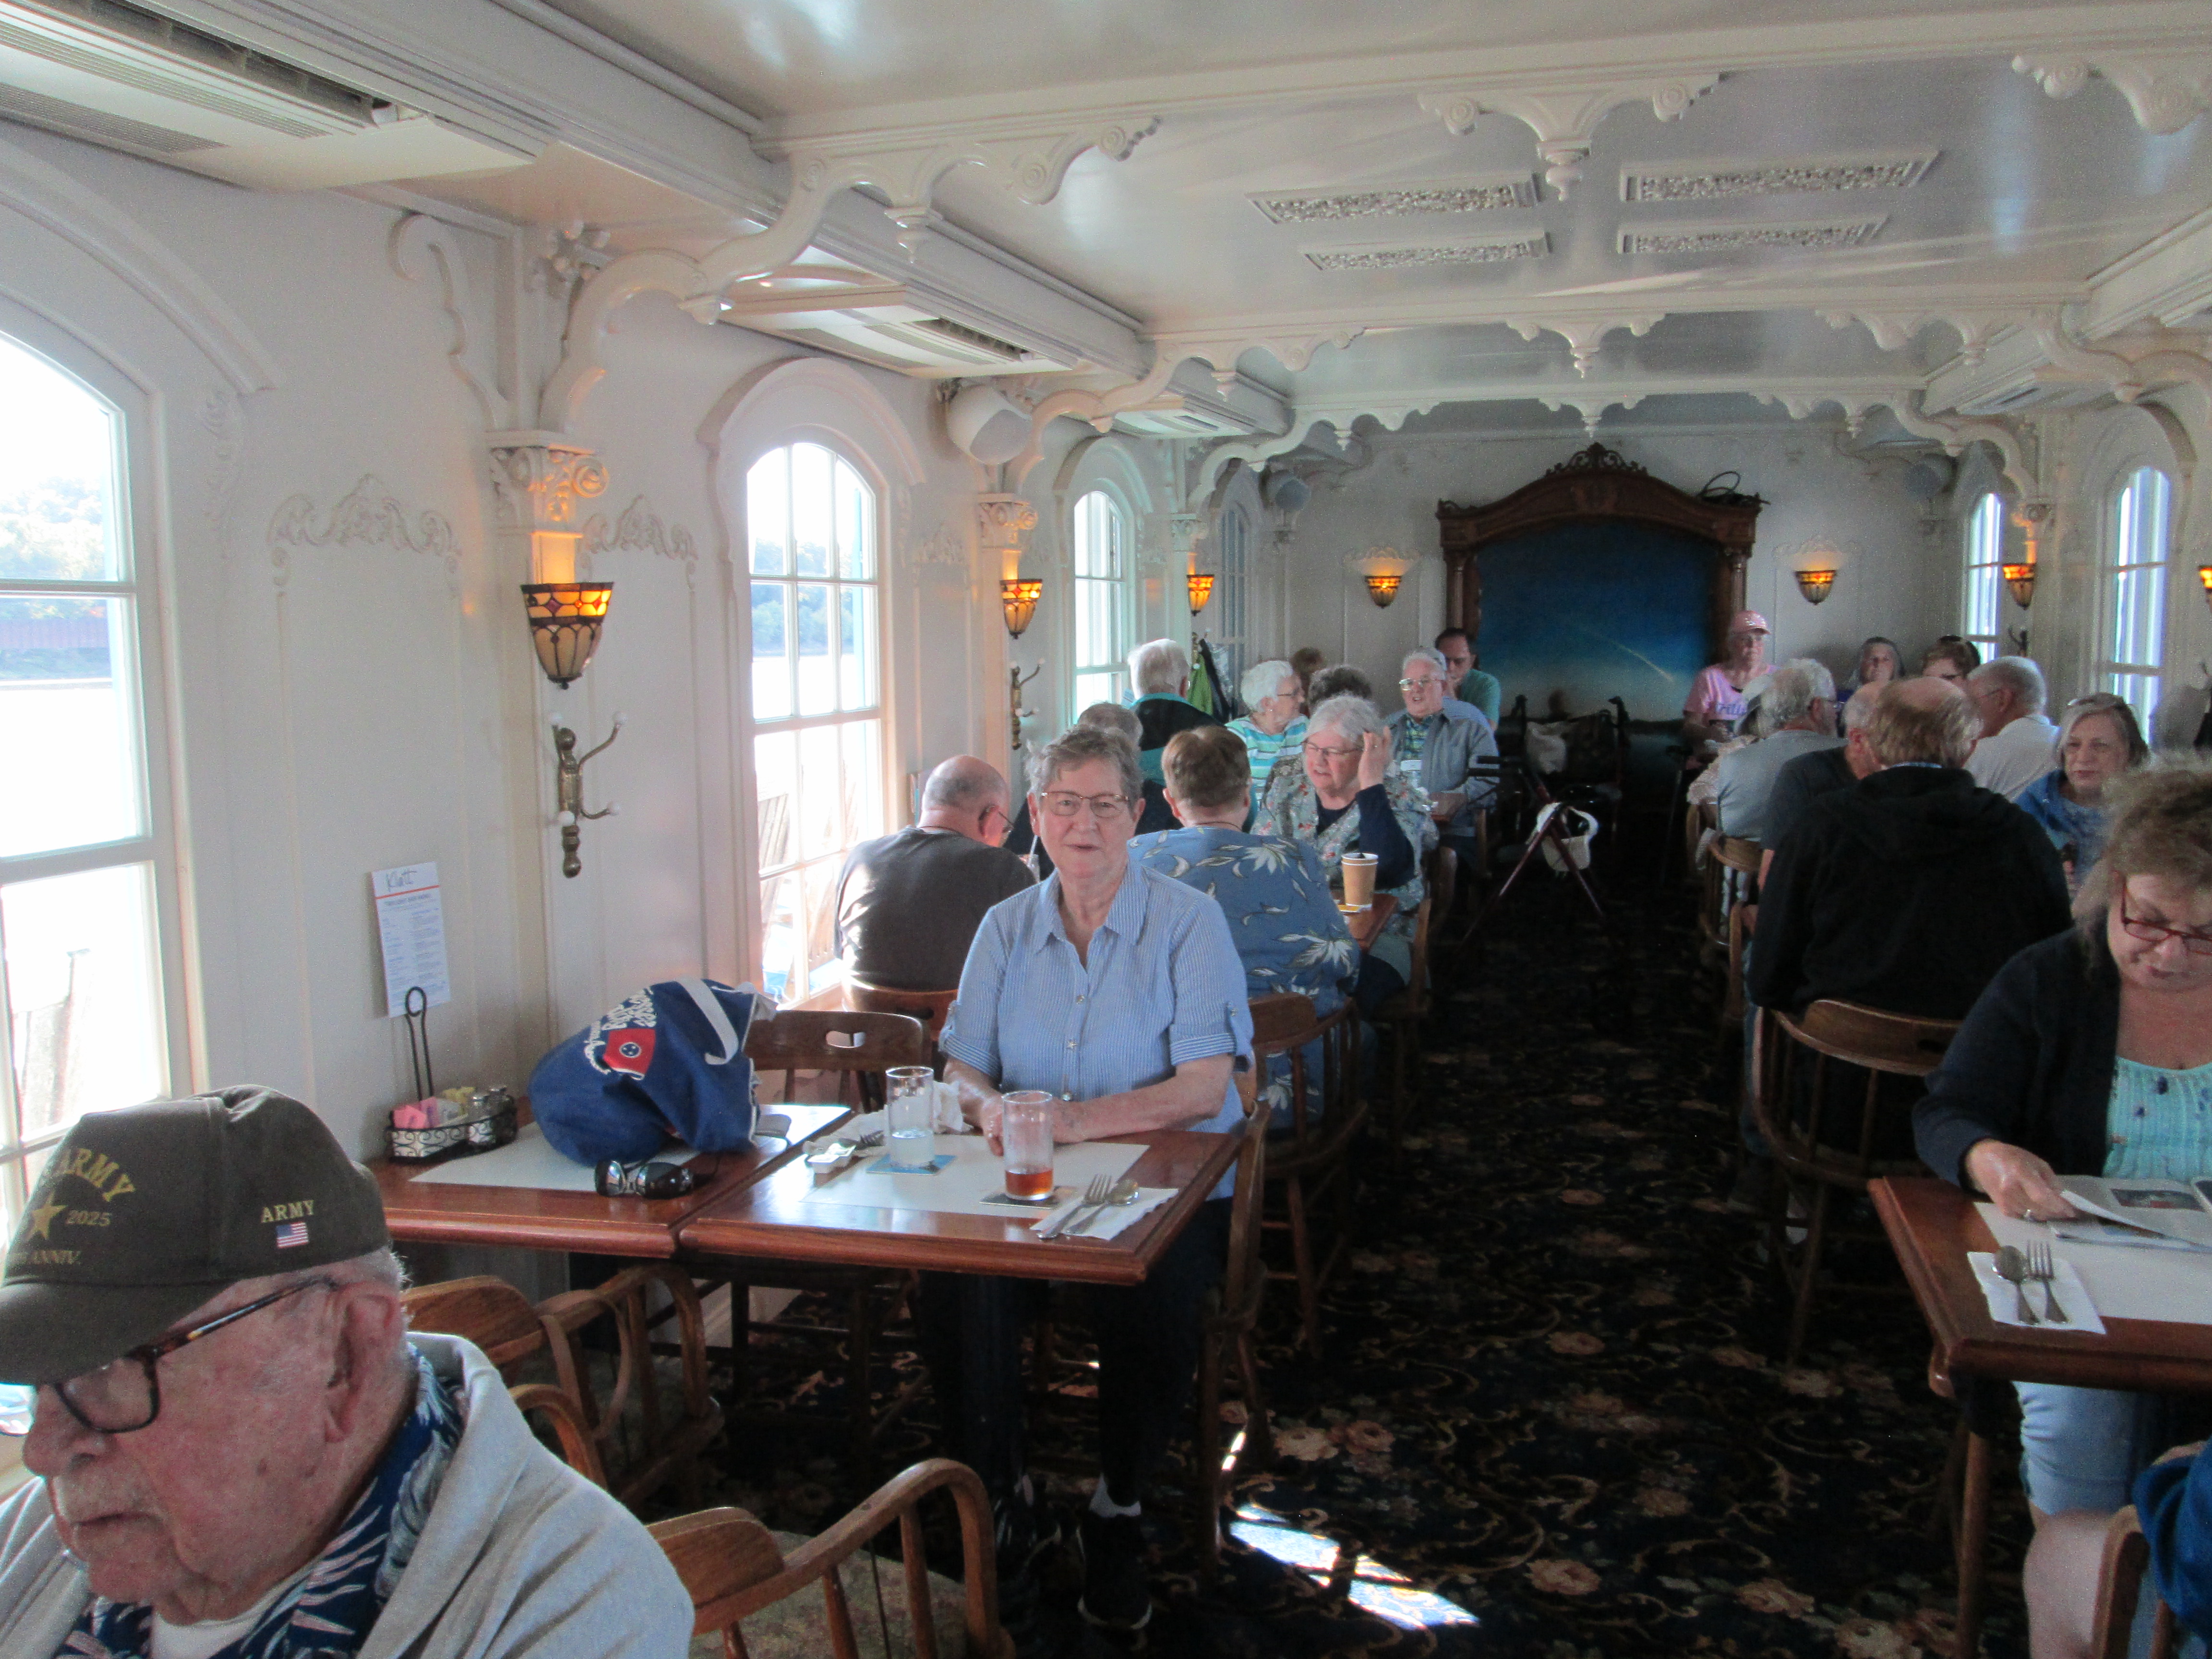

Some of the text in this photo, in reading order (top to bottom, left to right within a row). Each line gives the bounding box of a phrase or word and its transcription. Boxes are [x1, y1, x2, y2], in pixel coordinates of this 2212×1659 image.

[50, 1148, 136, 1202] ARMY
[65, 1210, 112, 1226] 2025
[261, 1200, 314, 1223] ARMY
